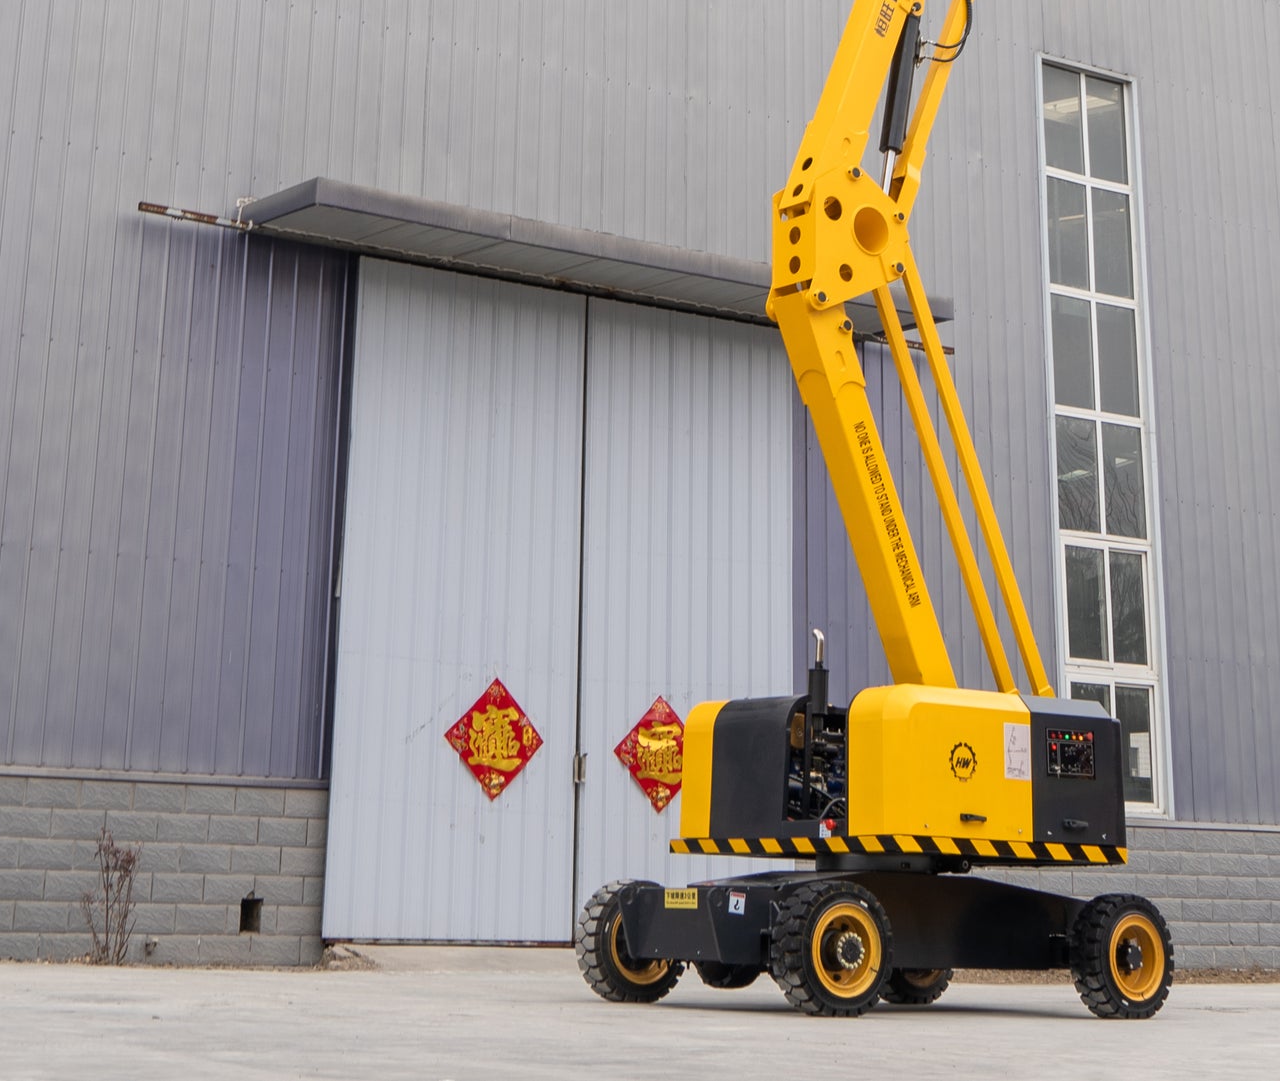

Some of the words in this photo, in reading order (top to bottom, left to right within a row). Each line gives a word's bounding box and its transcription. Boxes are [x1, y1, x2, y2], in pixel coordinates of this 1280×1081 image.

[854, 421, 866, 433] NO
[857, 432, 871, 448] ONE
[862, 446, 873, 455] IS
[864, 454, 882, 485] ALLOWED
[874, 483, 886, 495] TO
[876, 493, 893, 516] STAND
[884, 514, 900, 540] UNDER
[890, 537, 904, 552] THE
[895, 550, 916, 593] MECHANICAL
[907, 592, 921, 608] ARM
[955, 756, 972, 769] HW
